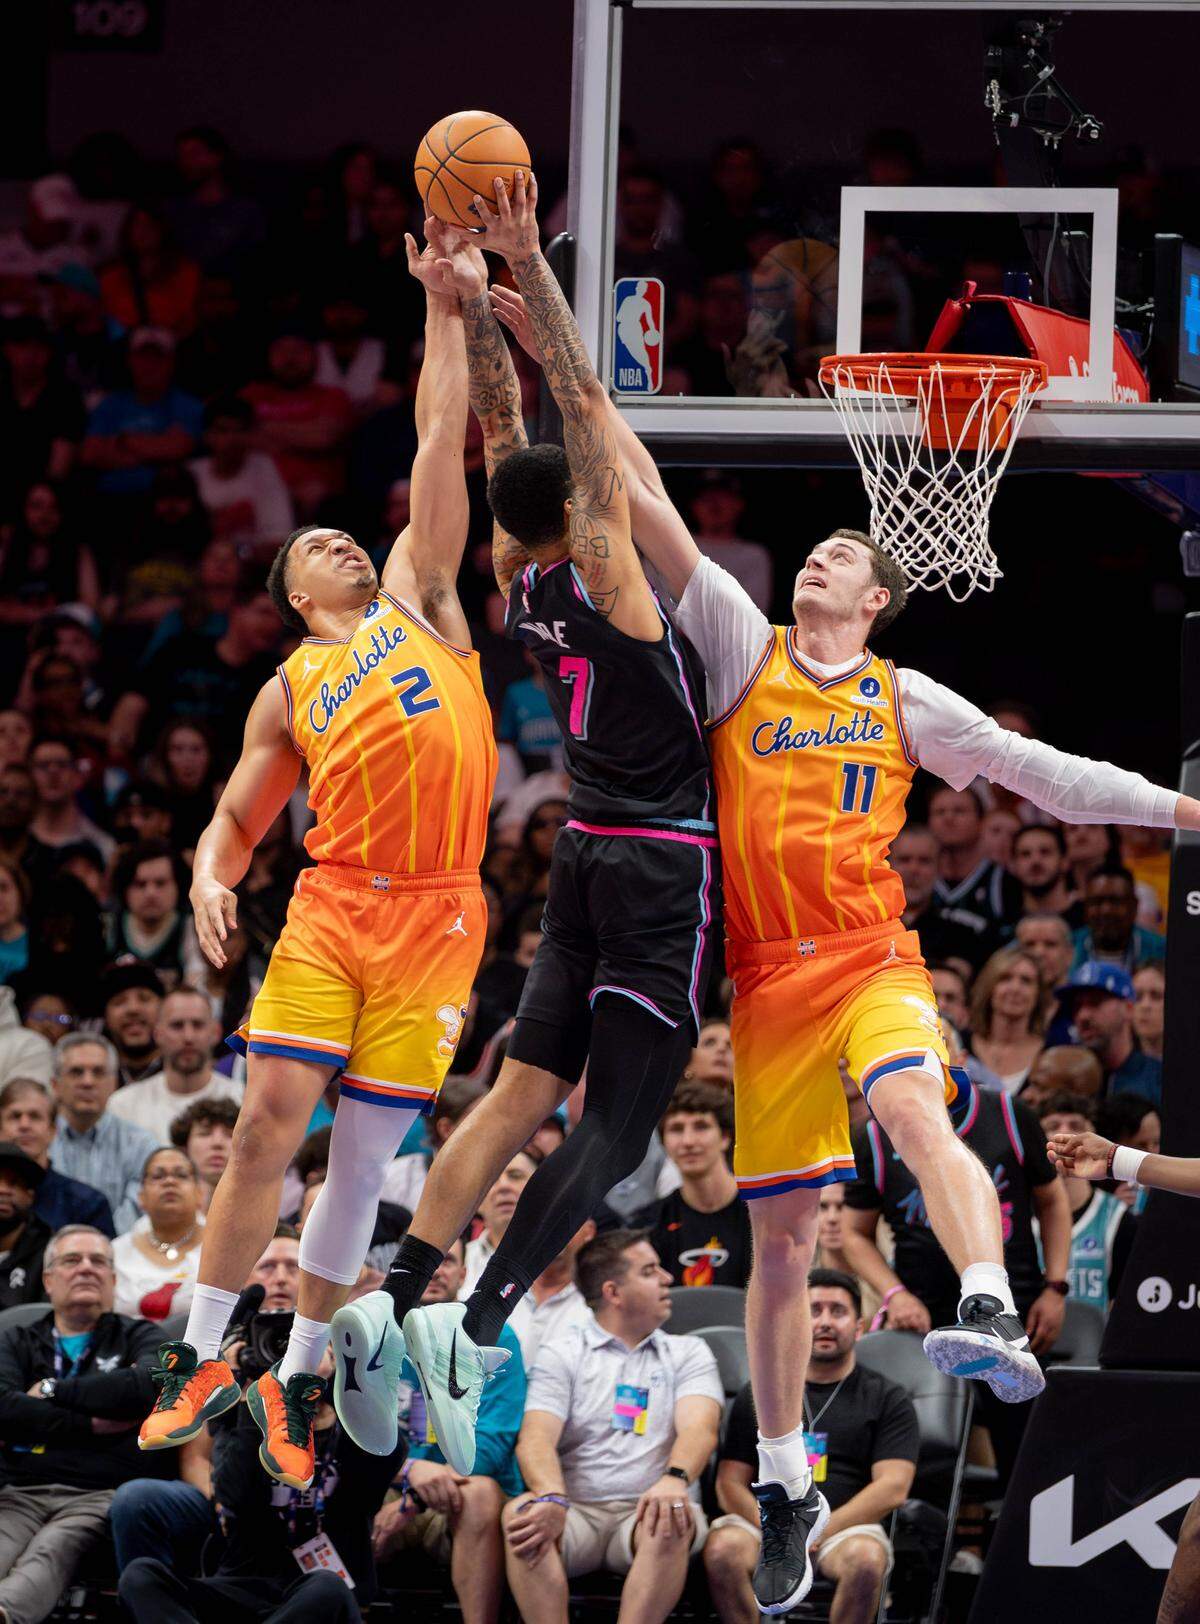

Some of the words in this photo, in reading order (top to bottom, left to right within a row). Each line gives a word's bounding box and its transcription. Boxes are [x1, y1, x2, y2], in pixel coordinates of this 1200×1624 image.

[72, 0, 149, 37] 109
[619, 367, 643, 387] NBA
[309, 625, 408, 734] Charlotte
[390, 666, 441, 717] 2
[558, 655, 595, 741] 7
[752, 709, 885, 757] Charlotte
[841, 761, 877, 814] 11
